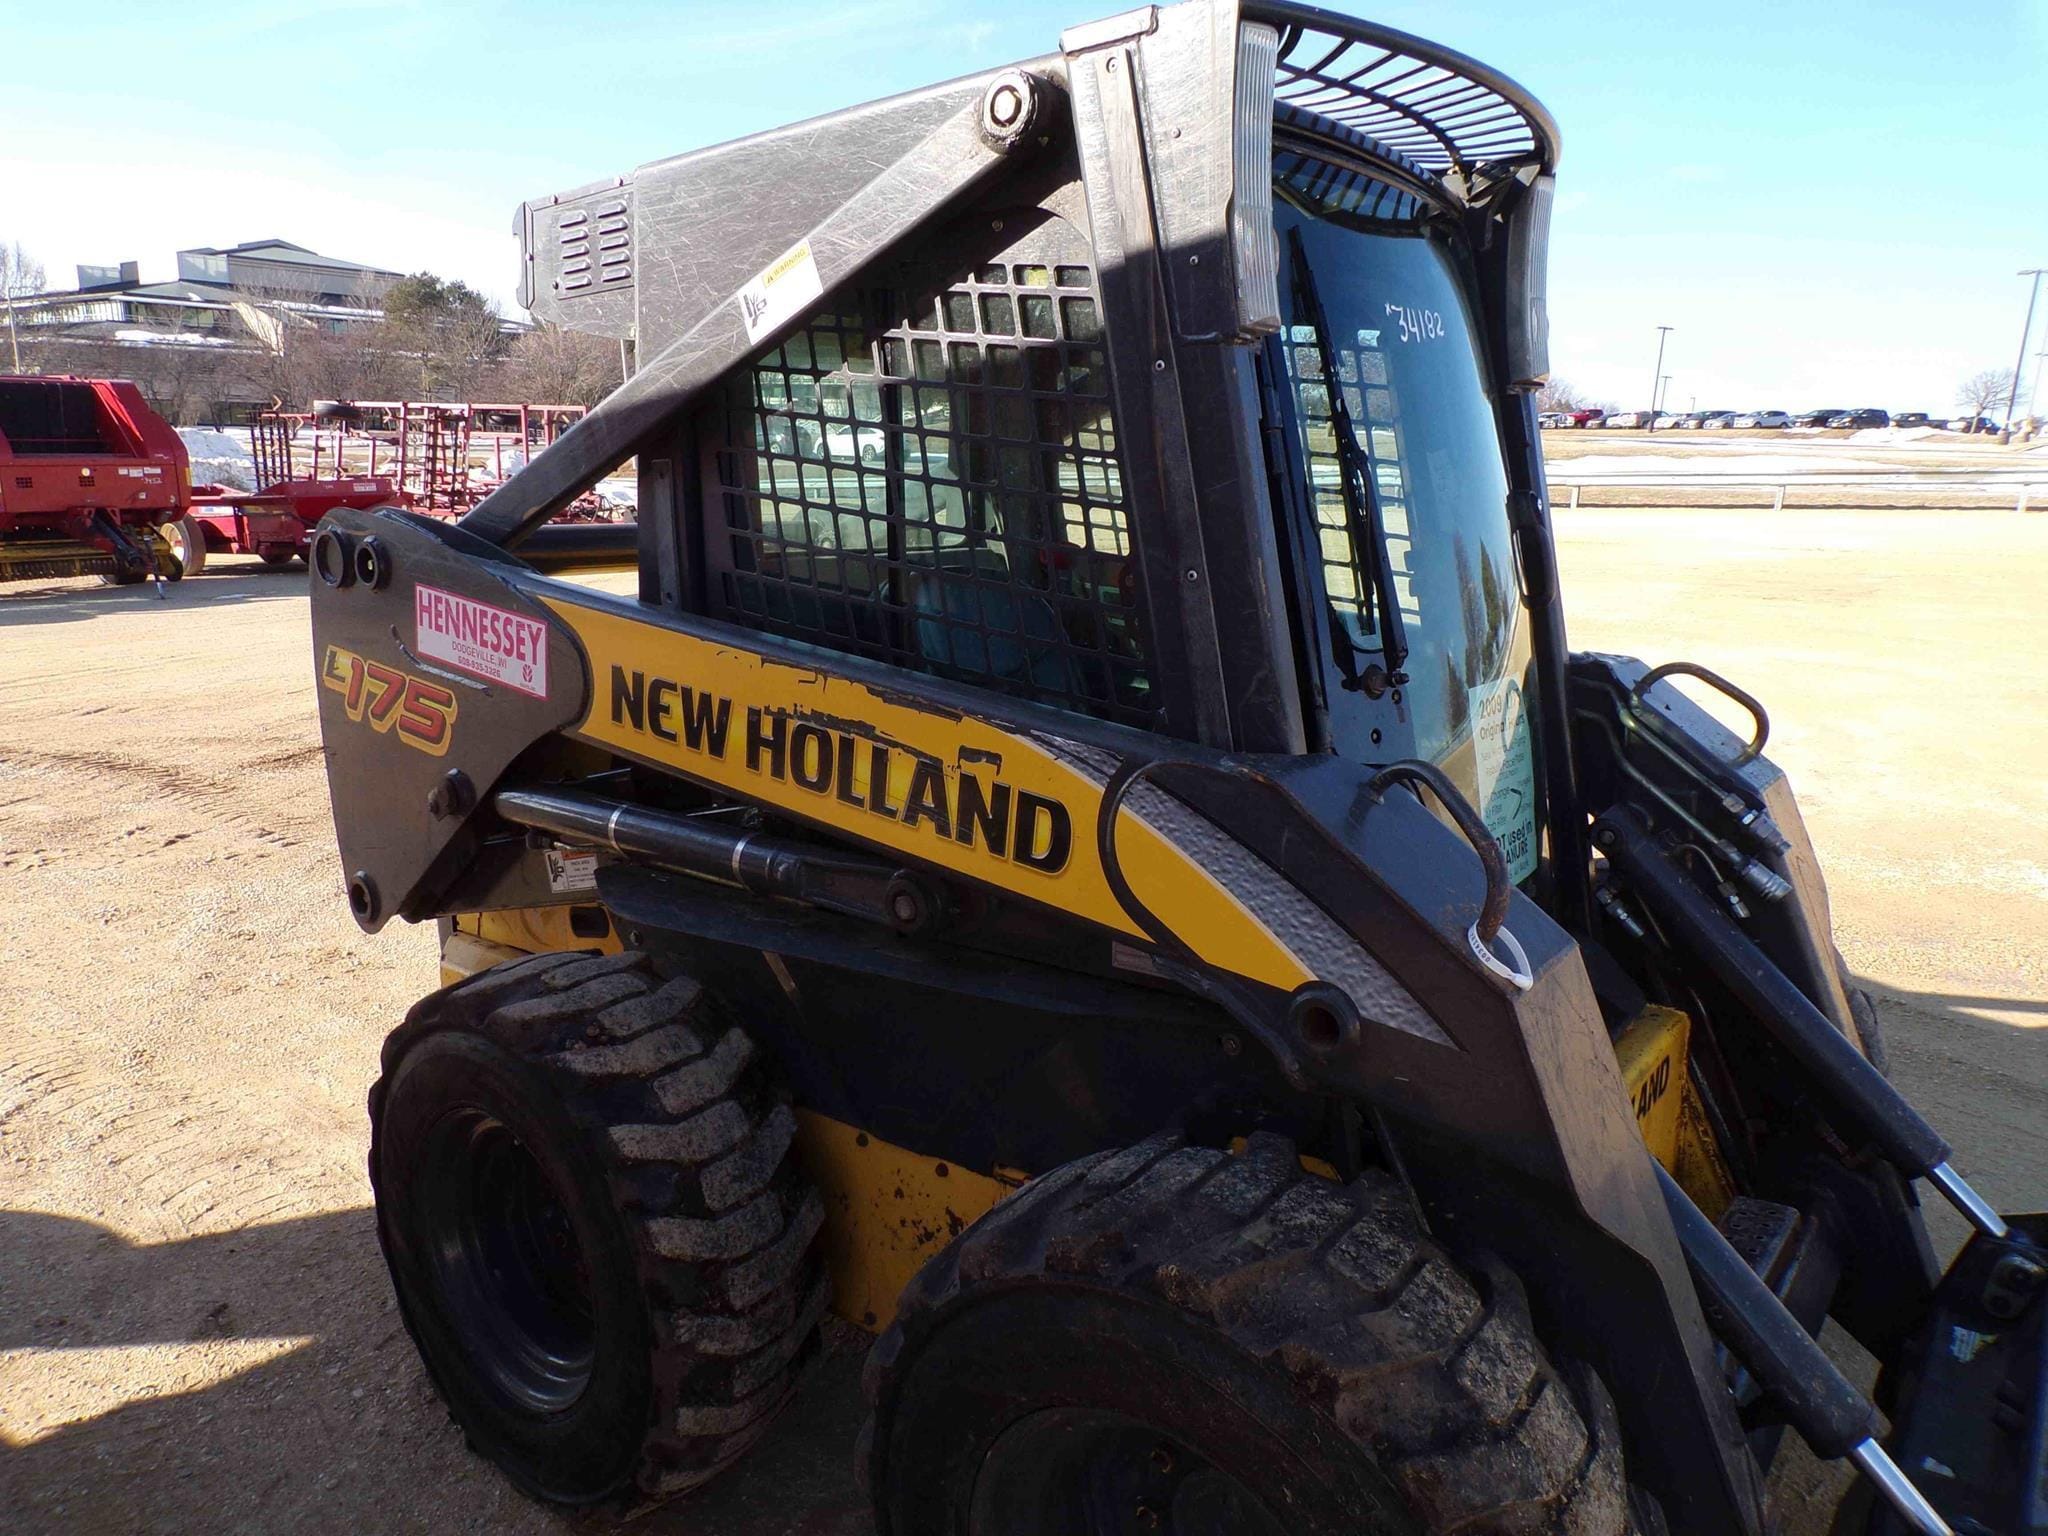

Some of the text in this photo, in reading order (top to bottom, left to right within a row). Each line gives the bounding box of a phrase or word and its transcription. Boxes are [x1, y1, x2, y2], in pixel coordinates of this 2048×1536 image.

[772, 248, 806, 276] WARNING
[418, 590, 543, 664] HENNESSEY
[322, 645, 458, 756] L175
[1479, 694, 1502, 719] 2009
[611, 664, 1073, 875] NEW HOLLAND
[1506, 837, 1528, 865] ANURE
